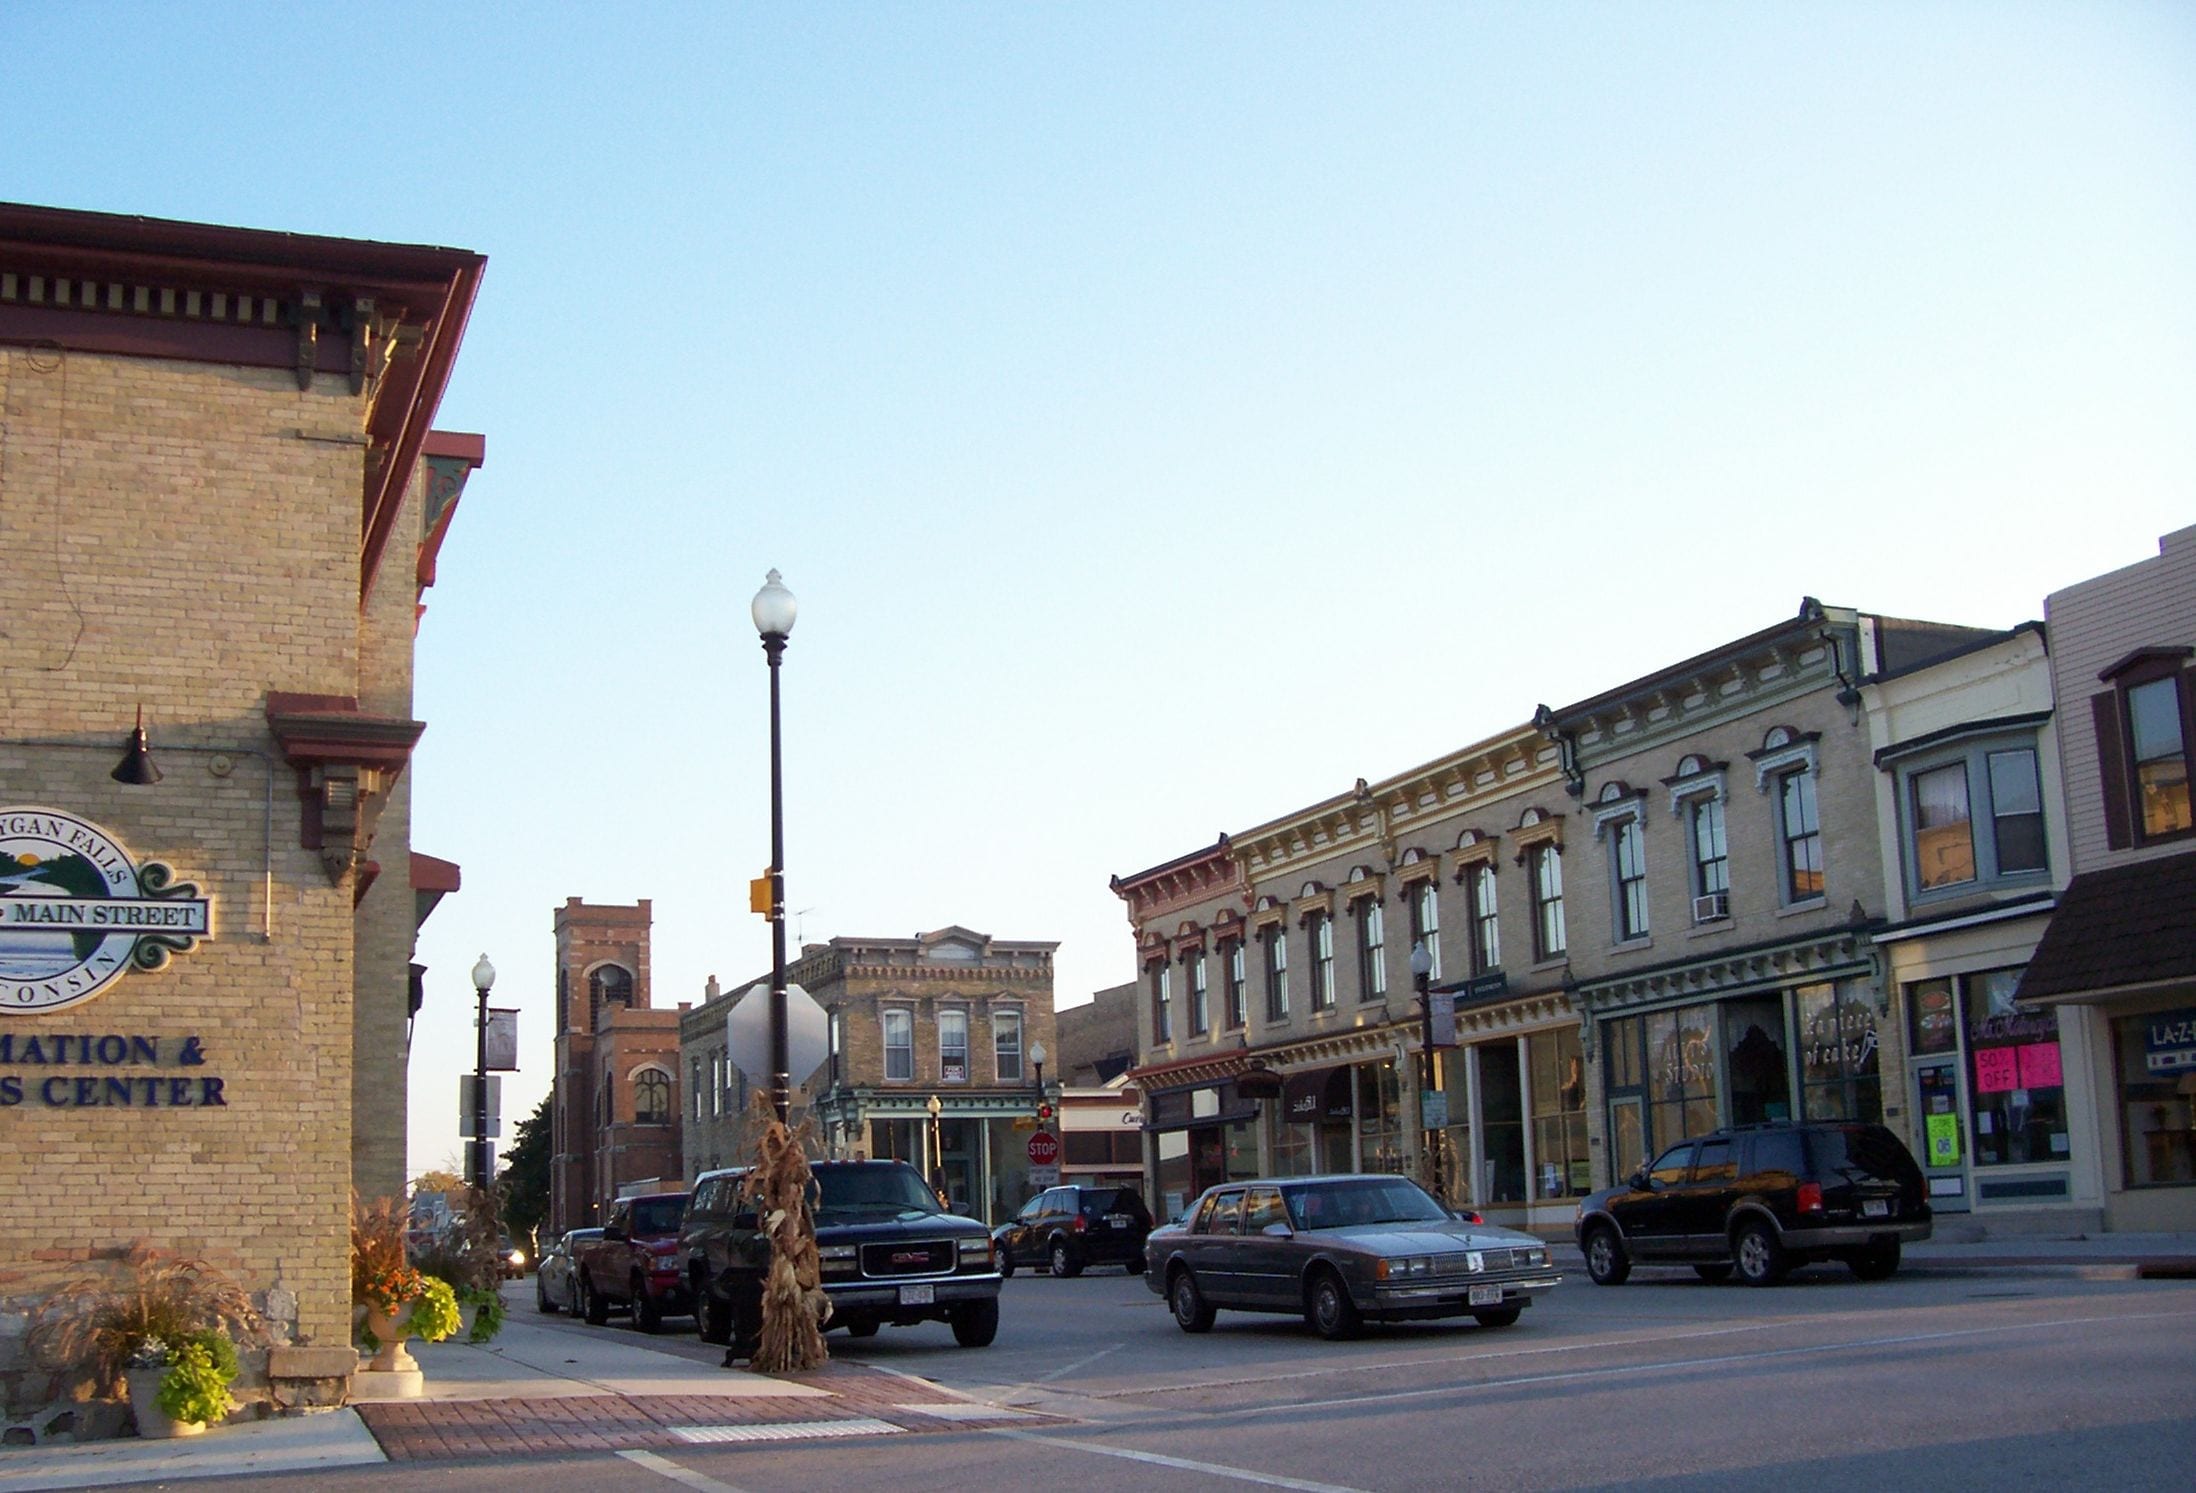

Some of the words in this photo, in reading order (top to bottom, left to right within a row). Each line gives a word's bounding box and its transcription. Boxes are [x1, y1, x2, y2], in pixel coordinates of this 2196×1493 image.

[68, 829, 127, 885] FALLS
[14, 904, 84, 923] MAIN
[93, 906, 196, 926] STREET
[179, 1036, 207, 1066] &
[42, 1076, 228, 1107] CENTER
[1985, 1069, 2010, 1089] OFF
[1029, 1142, 1057, 1155] STOP
